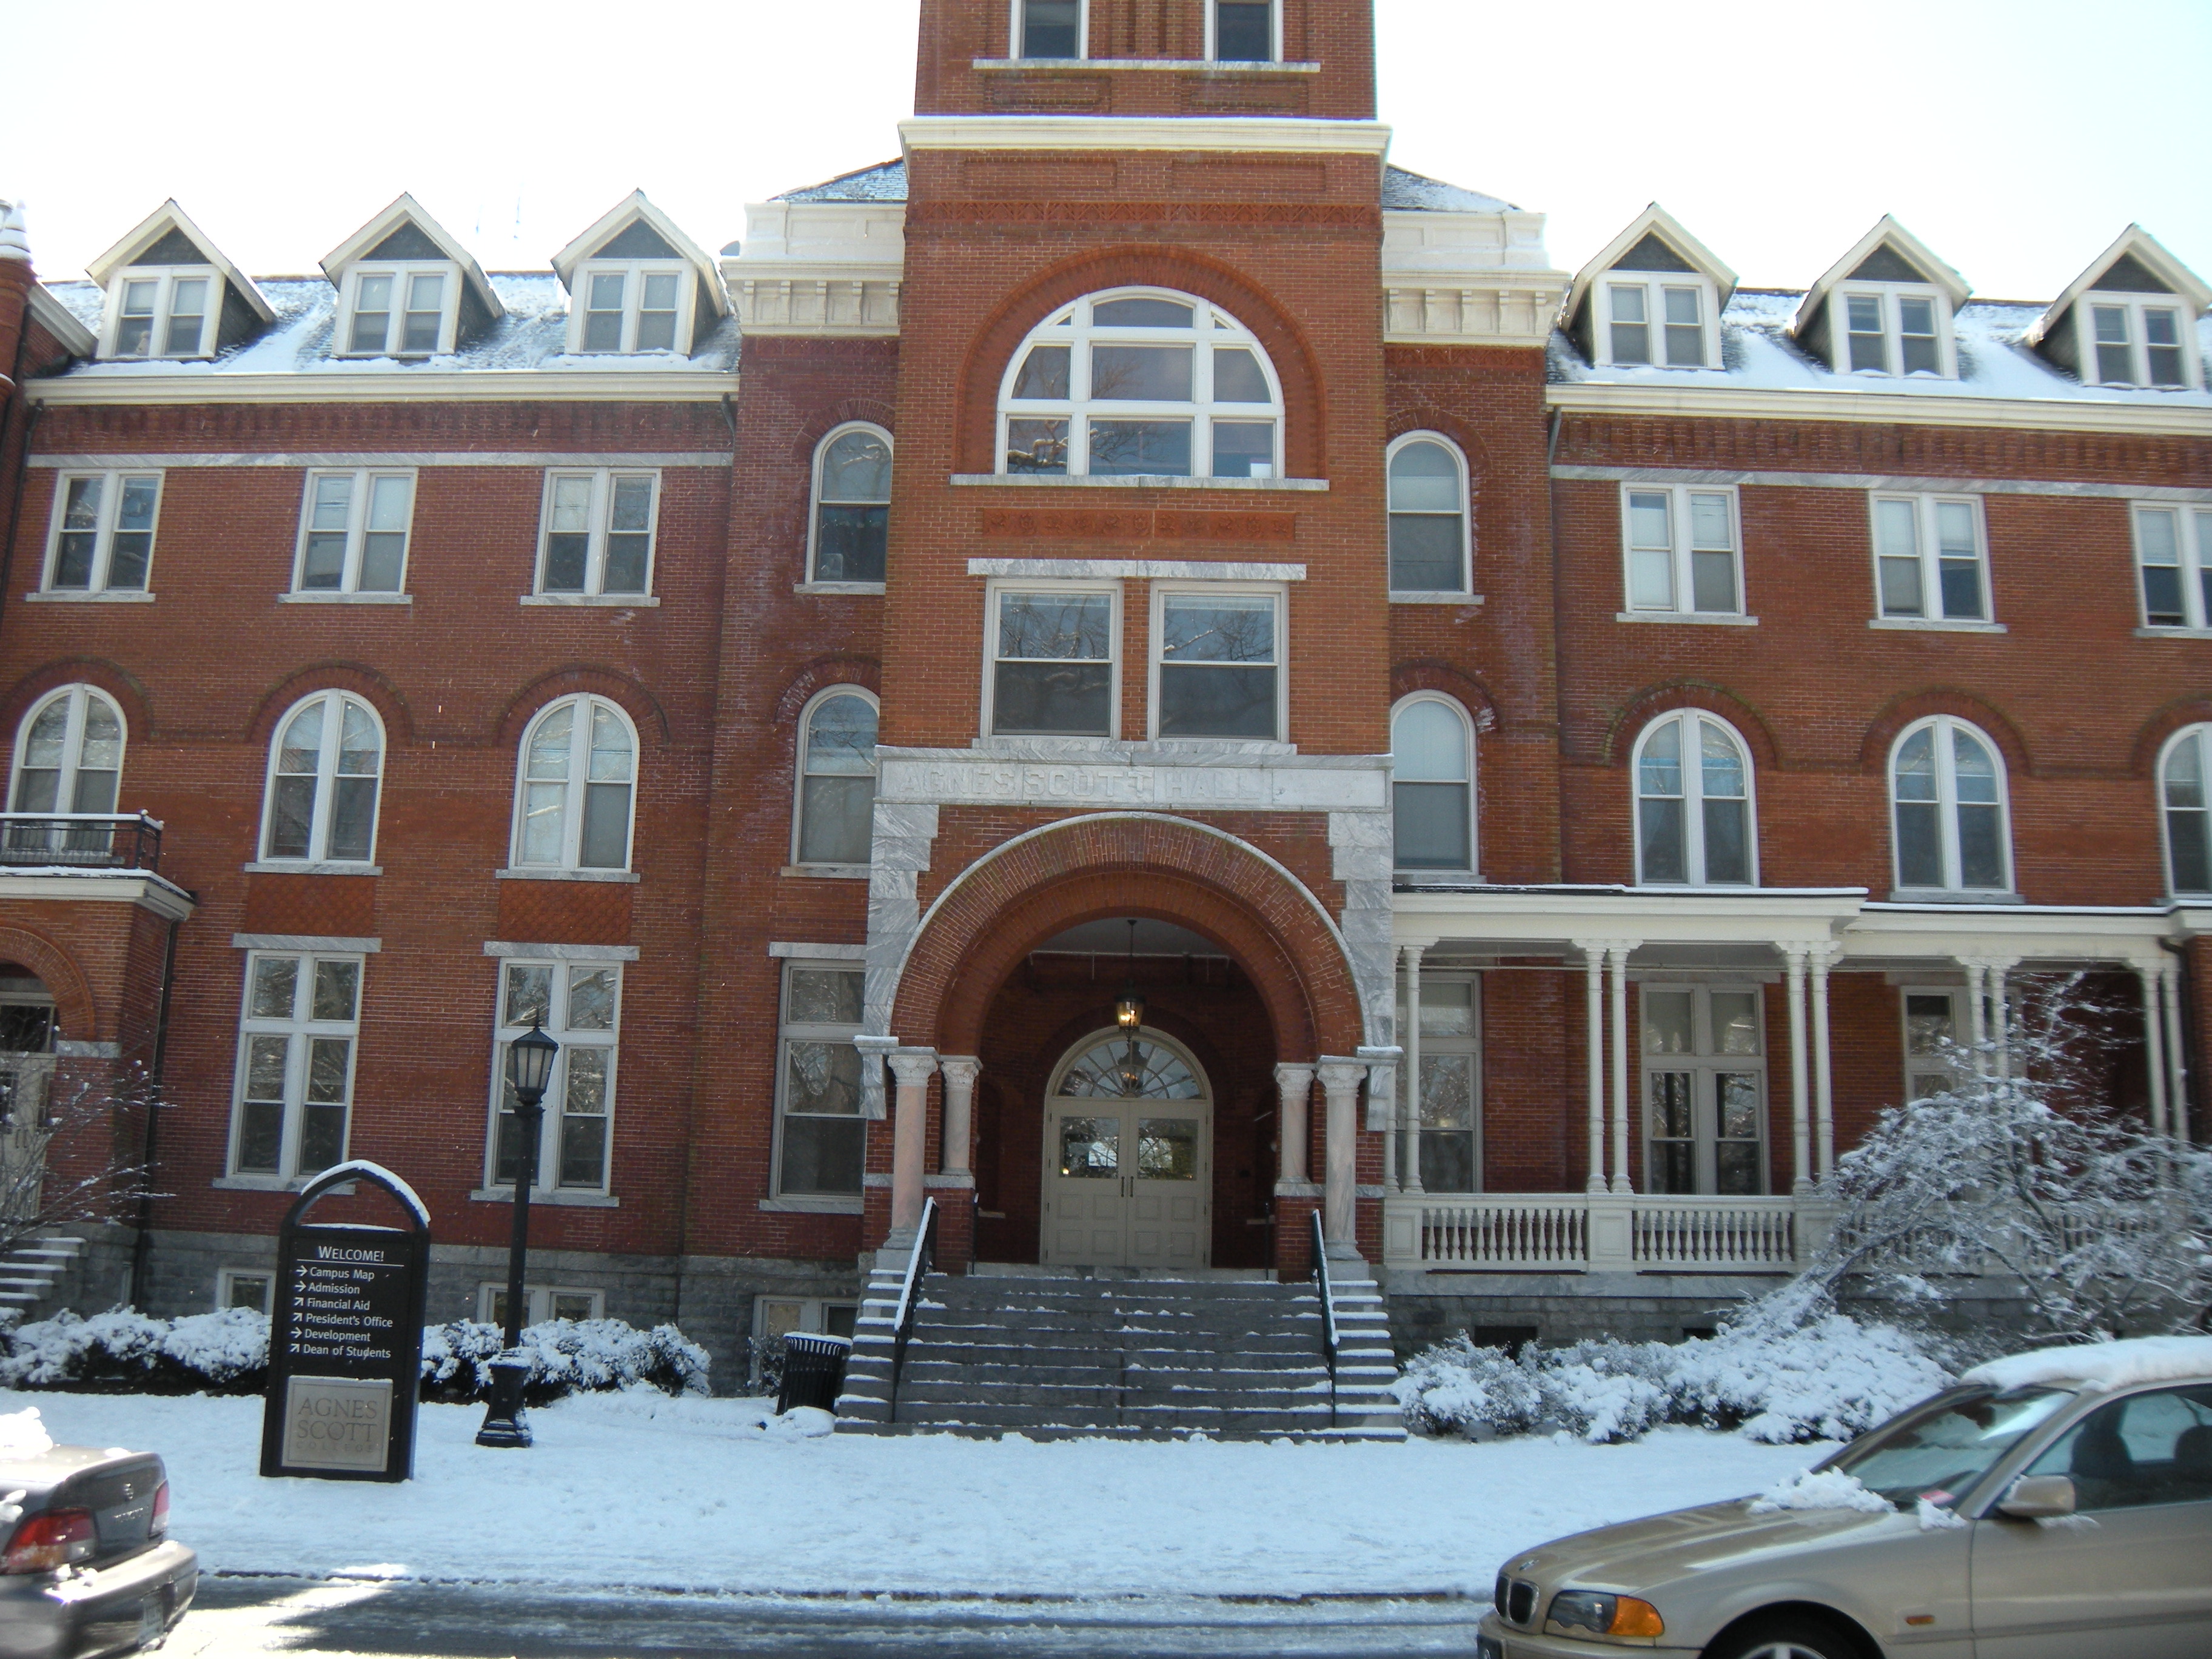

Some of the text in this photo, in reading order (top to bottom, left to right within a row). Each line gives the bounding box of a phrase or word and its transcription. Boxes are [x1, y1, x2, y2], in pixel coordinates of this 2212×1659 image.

[900, 766, 1261, 799] AGNES SCOTT HALL
[319, 1245, 384, 1261] WELCOME!
[310, 1267, 375, 1281] Campus Map
[308, 1282, 360, 1295] Admission
[307, 1298, 370, 1310] Financial Aid
[306, 1313, 393, 1327] President's Office
[304, 1329, 370, 1342] Development
[304, 1344, 391, 1358] Dean of Students
[298, 1397, 378, 1419] AGNES
[297, 1419, 377, 1442] SCOTT
